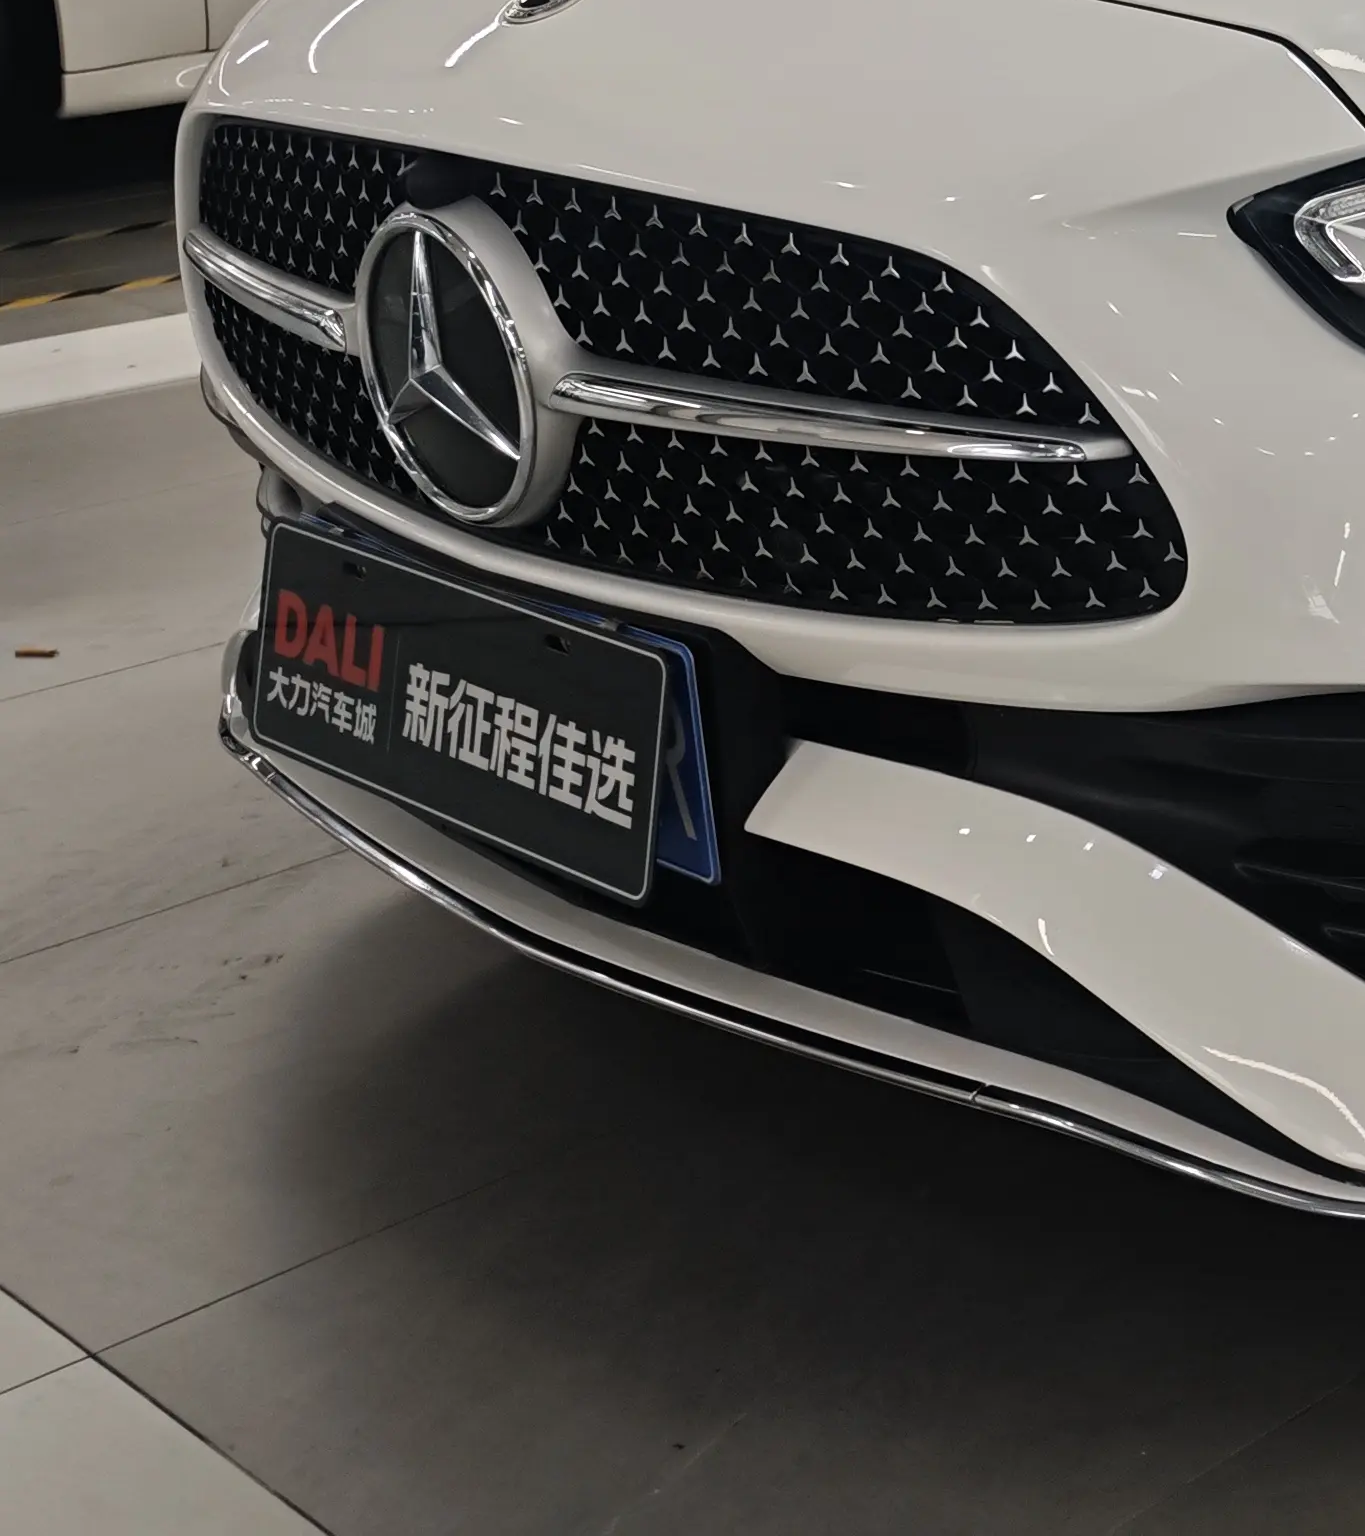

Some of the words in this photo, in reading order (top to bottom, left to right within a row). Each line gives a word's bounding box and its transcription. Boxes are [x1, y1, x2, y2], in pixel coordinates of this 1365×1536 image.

[274, 589, 386, 693] DALI
[266, 666, 378, 746] 大力汽车城
[402, 663, 637, 830] 新征程佳选
